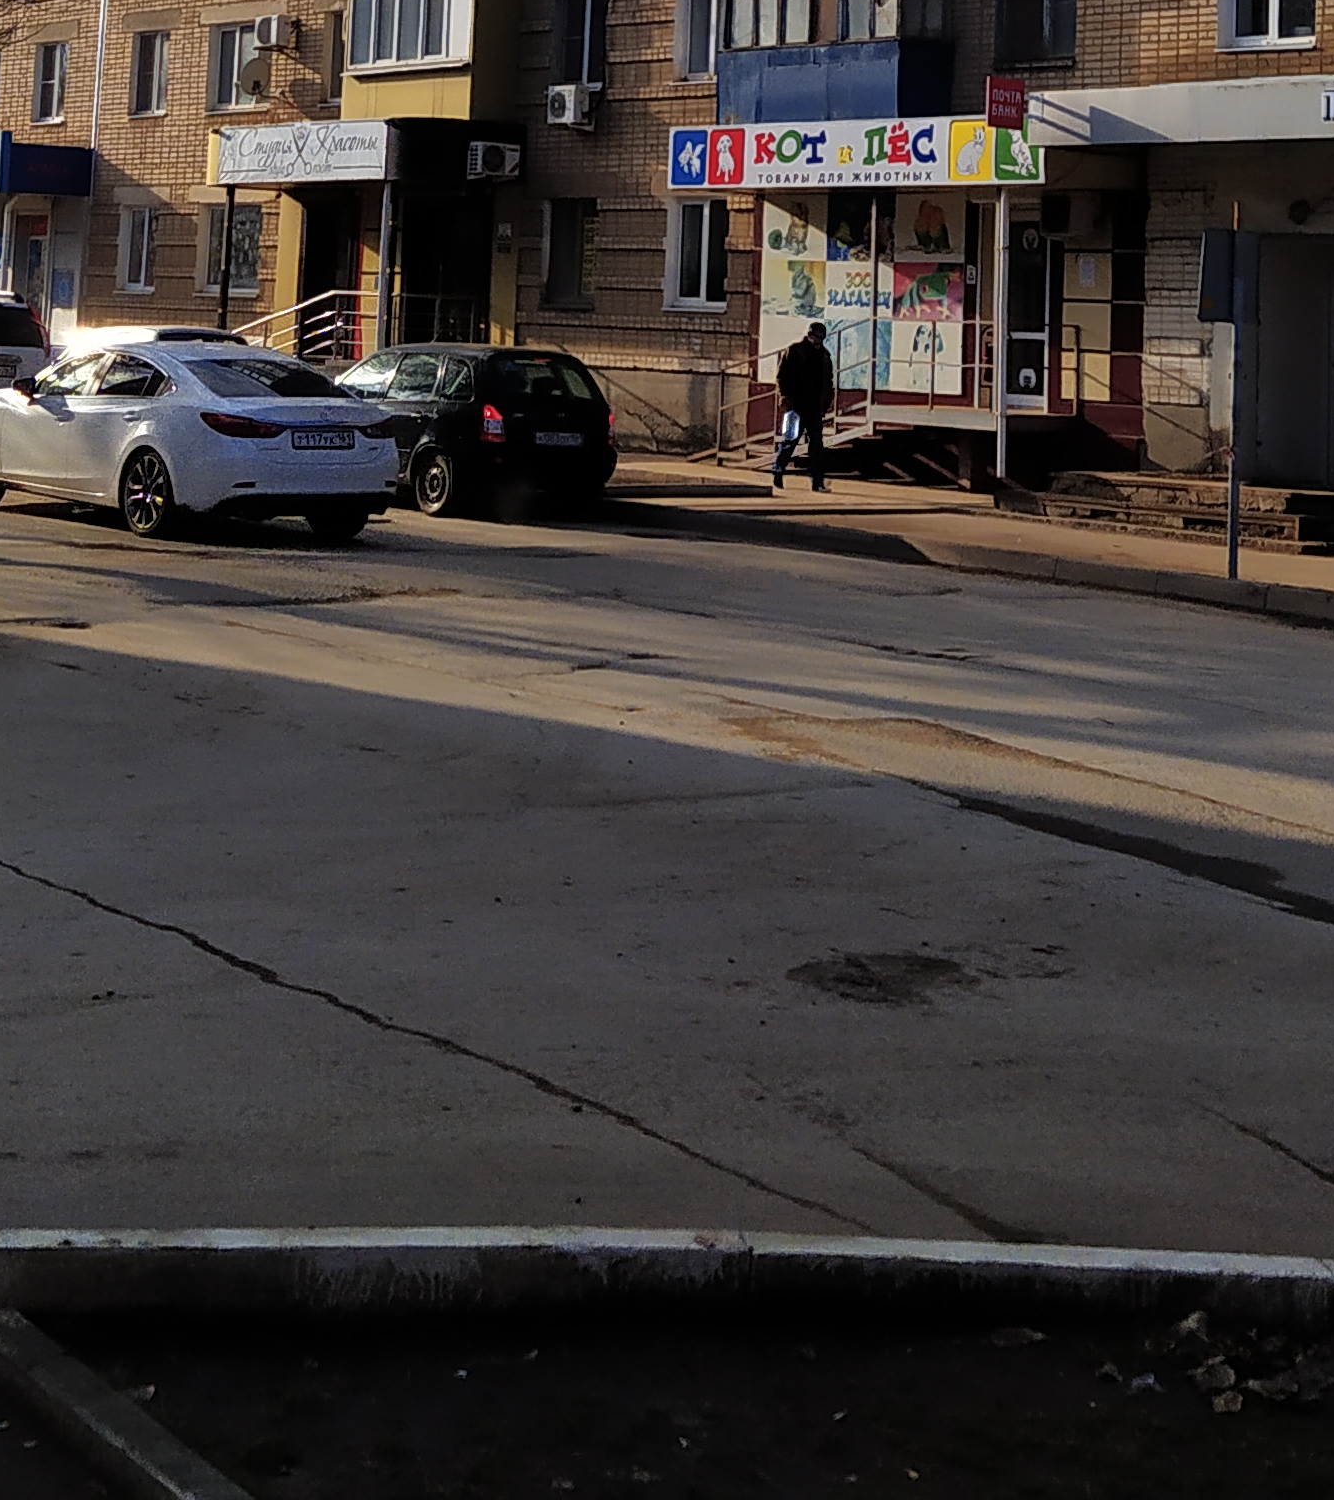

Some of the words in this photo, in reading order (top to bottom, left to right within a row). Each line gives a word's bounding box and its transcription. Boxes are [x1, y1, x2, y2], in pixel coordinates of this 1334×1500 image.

[992, 88, 1022, 104] ПОЧТА
[991, 102, 1018, 118] БАНК
[238, 129, 294, 168] Студия
[310, 125, 379, 164] Красоты
[753, 129, 827, 165] КОТ
[862, 121, 937, 166] ПЁС
[757, 172, 810, 185] ТОВАРЫ
[818, 172, 844, 185] ДЛЯ
[851, 170, 933, 183] ЖИВОТНЫХ
